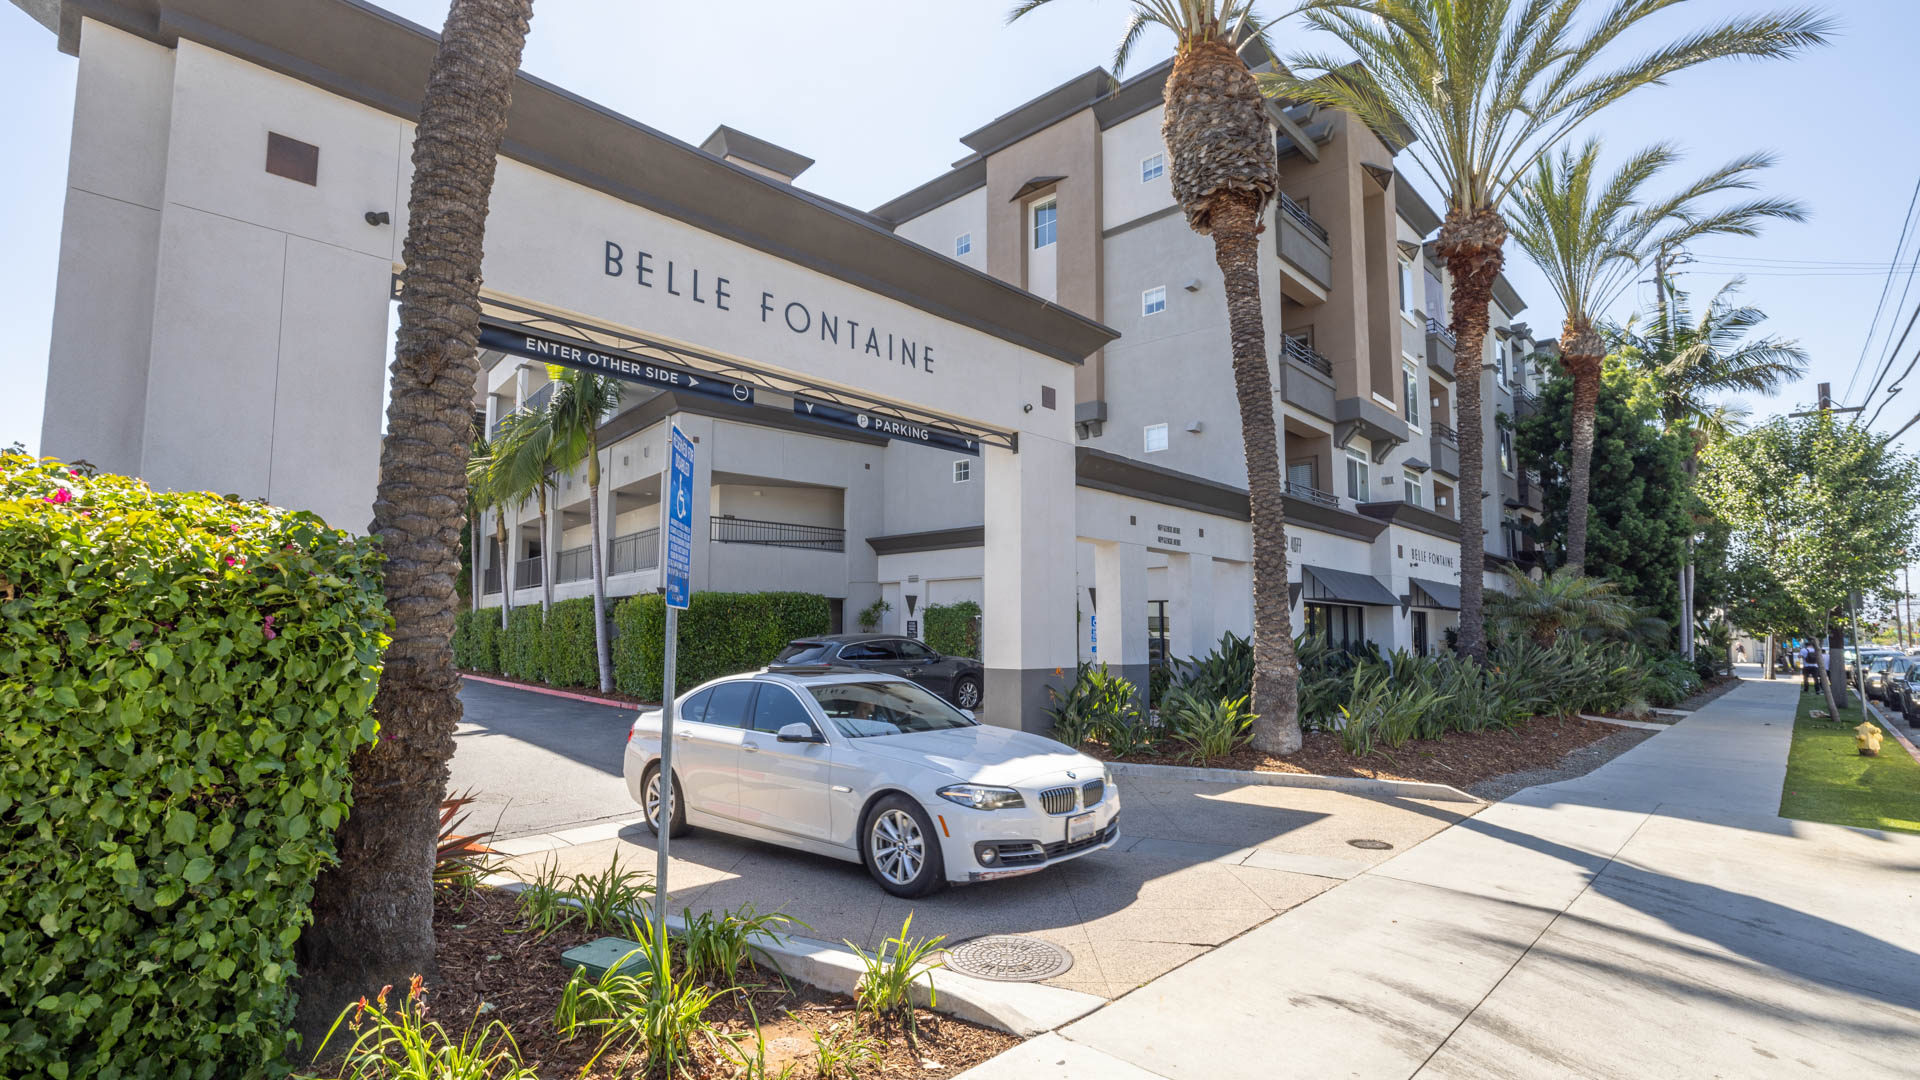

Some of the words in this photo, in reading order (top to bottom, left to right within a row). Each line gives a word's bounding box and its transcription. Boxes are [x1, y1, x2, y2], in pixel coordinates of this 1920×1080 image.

[605, 241, 731, 311] BELLE
[761, 292, 934, 374] FONTAINE
[526, 337, 581, 361] ENTER
[587, 353, 640, 375] OTHER
[646, 367, 679, 384] SIDE
[875, 418, 929, 440] PARKING
[1411, 548, 1427, 563] BELLE
[1428, 552, 1454, 569] FONTAINE
